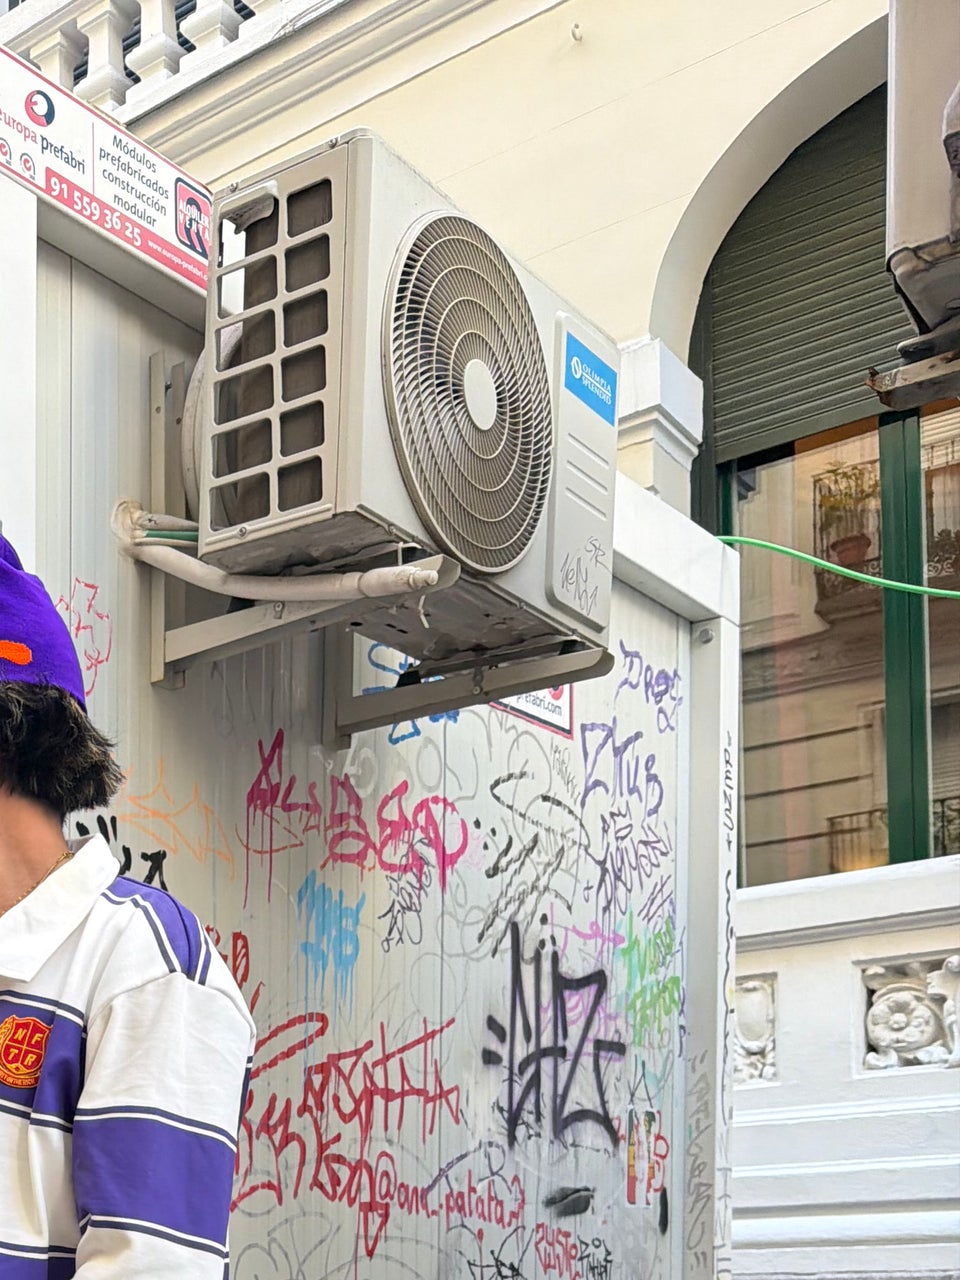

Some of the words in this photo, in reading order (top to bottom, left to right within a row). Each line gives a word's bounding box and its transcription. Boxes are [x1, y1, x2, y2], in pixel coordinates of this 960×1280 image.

[40, 134, 85, 175] prefabri
[112, 135, 157, 173] Módulos
[99, 147, 169, 200] prefabricados
[102, 168, 167, 216] construcción
[50, 176, 68, 199] 91
[73, 190, 101, 221] 559
[103, 209, 123, 231] 36
[124, 222, 142, 247] 25
[113, 193, 157, 228] modular
[147, 239, 208, 281] www.europa-prefabri.c
[581, 375, 612, 405] SPLENDID
[582, 363, 612, 394] OLIMPIA
[14, 1028, 27, 1041] N
[31, 1033, 44, 1045] F
[8, 1048, 19, 1060] T
[24, 1053, 37, 1066] R
